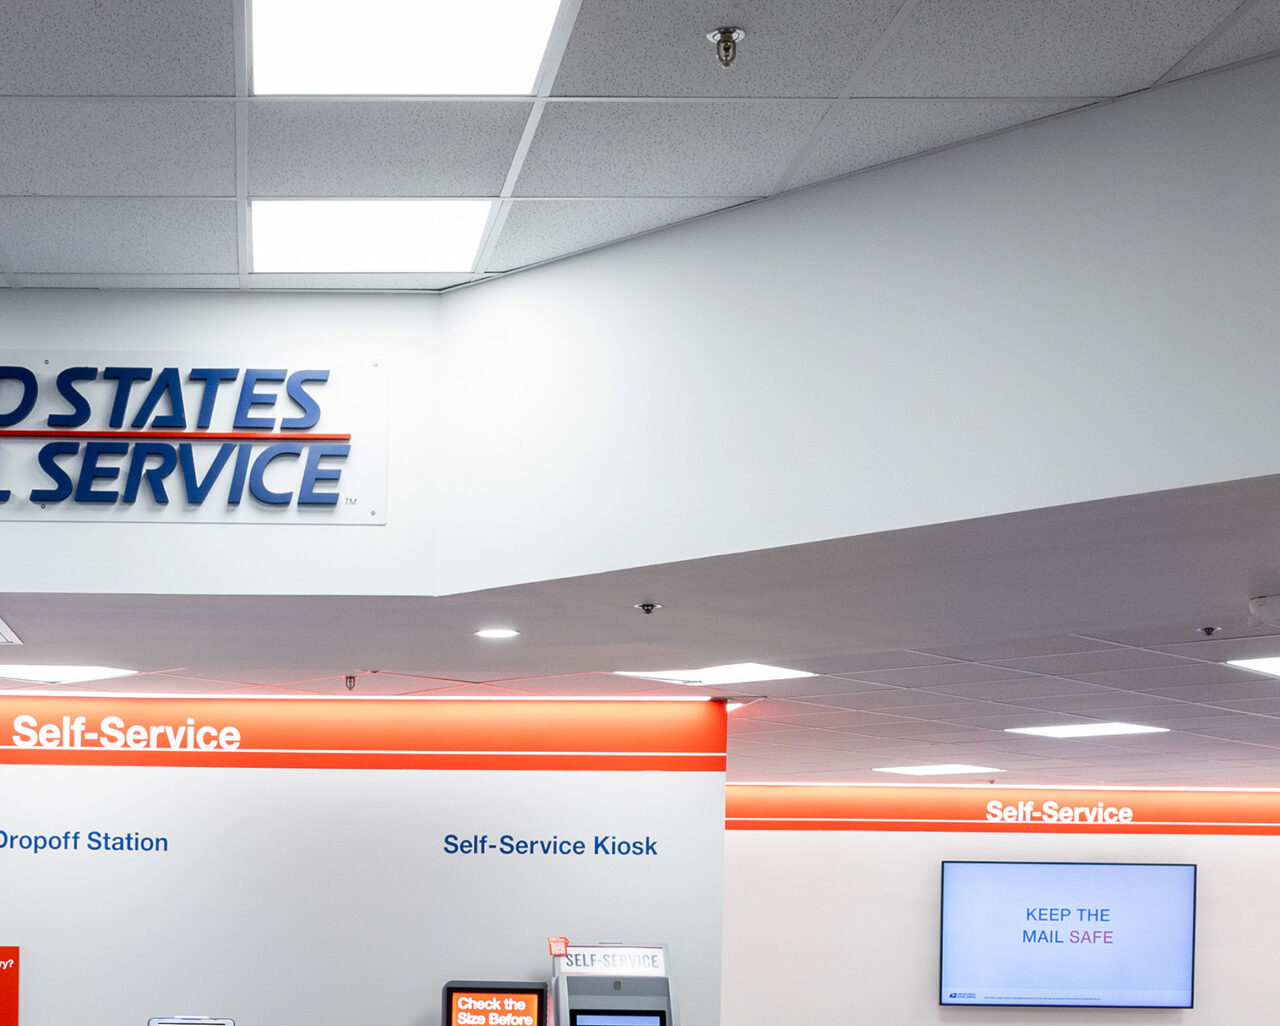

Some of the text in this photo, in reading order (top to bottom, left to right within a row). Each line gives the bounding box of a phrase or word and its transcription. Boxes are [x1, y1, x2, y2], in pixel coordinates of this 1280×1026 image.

[47, 366, 331, 430] STATES
[29, 440, 352, 506] SERVICE
[12, 715, 242, 751] Self-Service
[986, 800, 1134, 823] Self-Service
[87, 831, 169, 851] Station
[443, 834, 658, 855] Self-Service Kiosk
[1026, 908, 1110, 922] KEEP THE
[1022, 930, 1113, 944] MAIL SAFE
[566, 953, 659, 969] SELF-SERVICE
[457, 997, 526, 1011] Check the
[457, 1012, 533, 1026] Size Before
